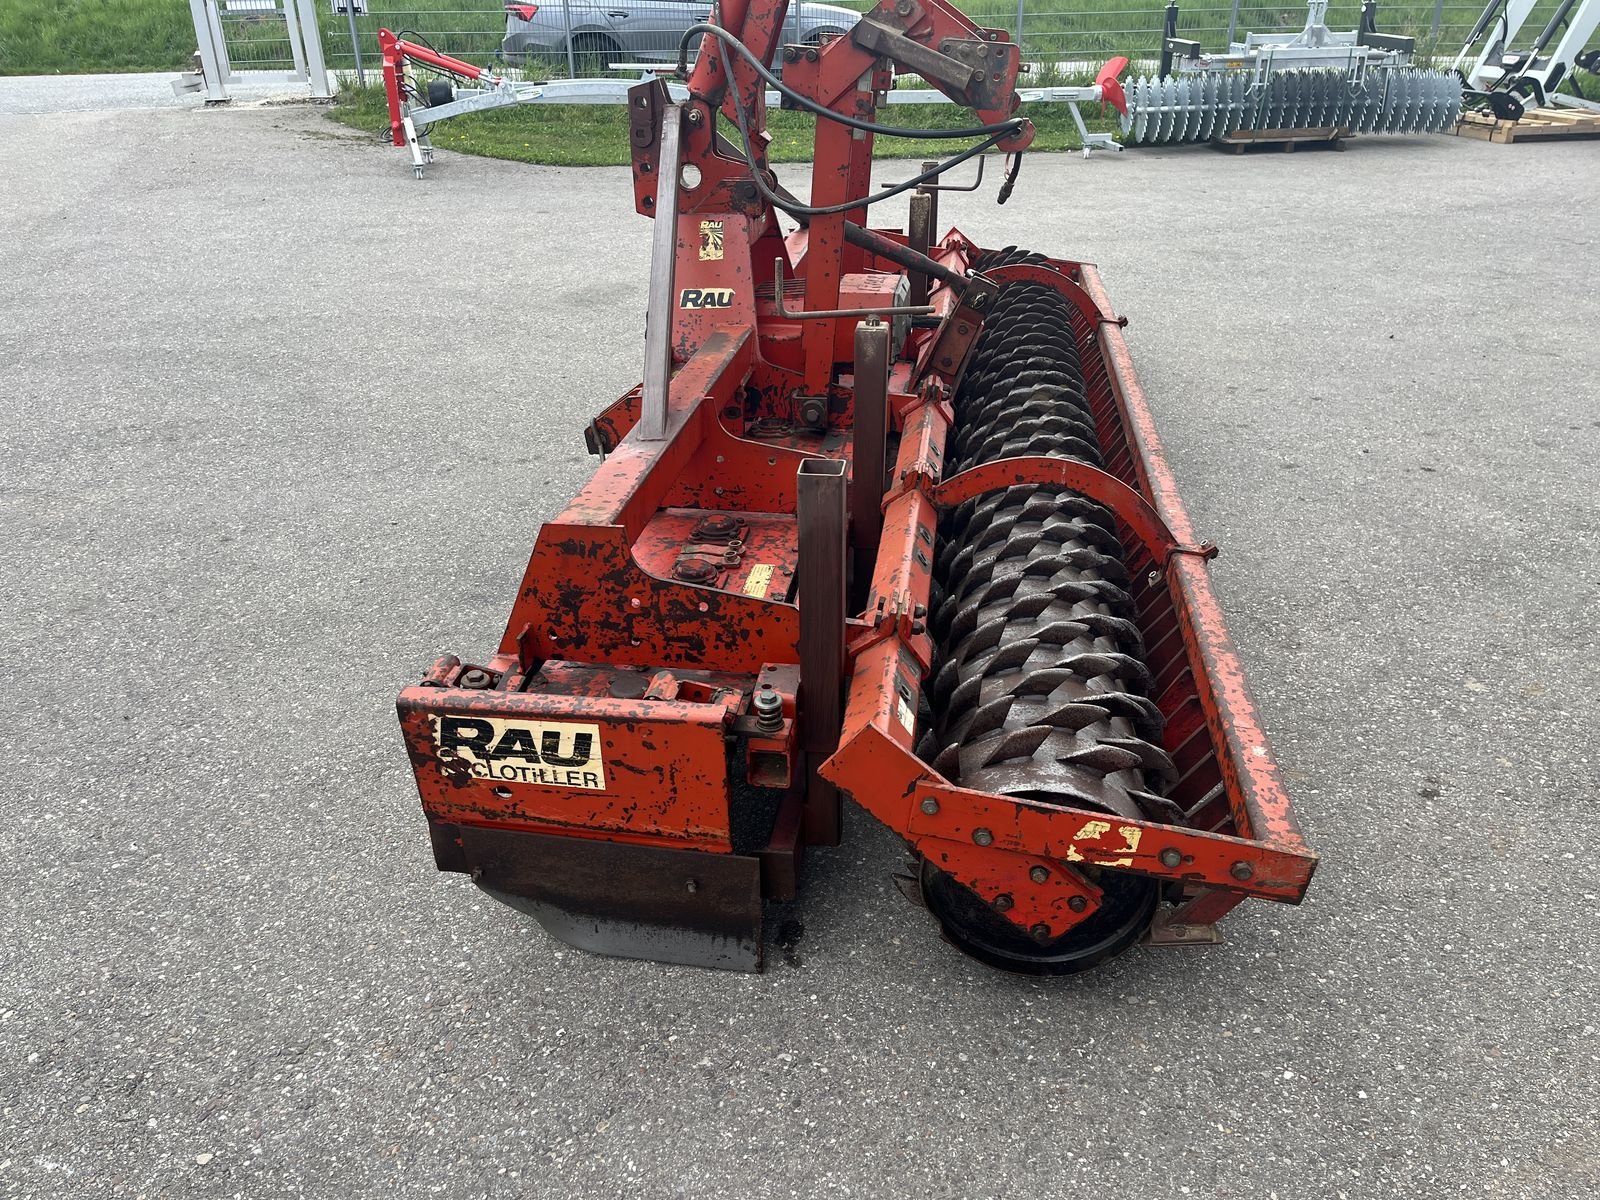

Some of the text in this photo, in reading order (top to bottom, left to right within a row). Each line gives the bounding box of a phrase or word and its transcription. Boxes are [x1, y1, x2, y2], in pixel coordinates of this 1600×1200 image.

[701, 221, 723, 229] RAU
[680, 289, 735, 308] RAU
[440, 717, 593, 768] RAU
[468, 761, 600, 788] CLOTILLER
